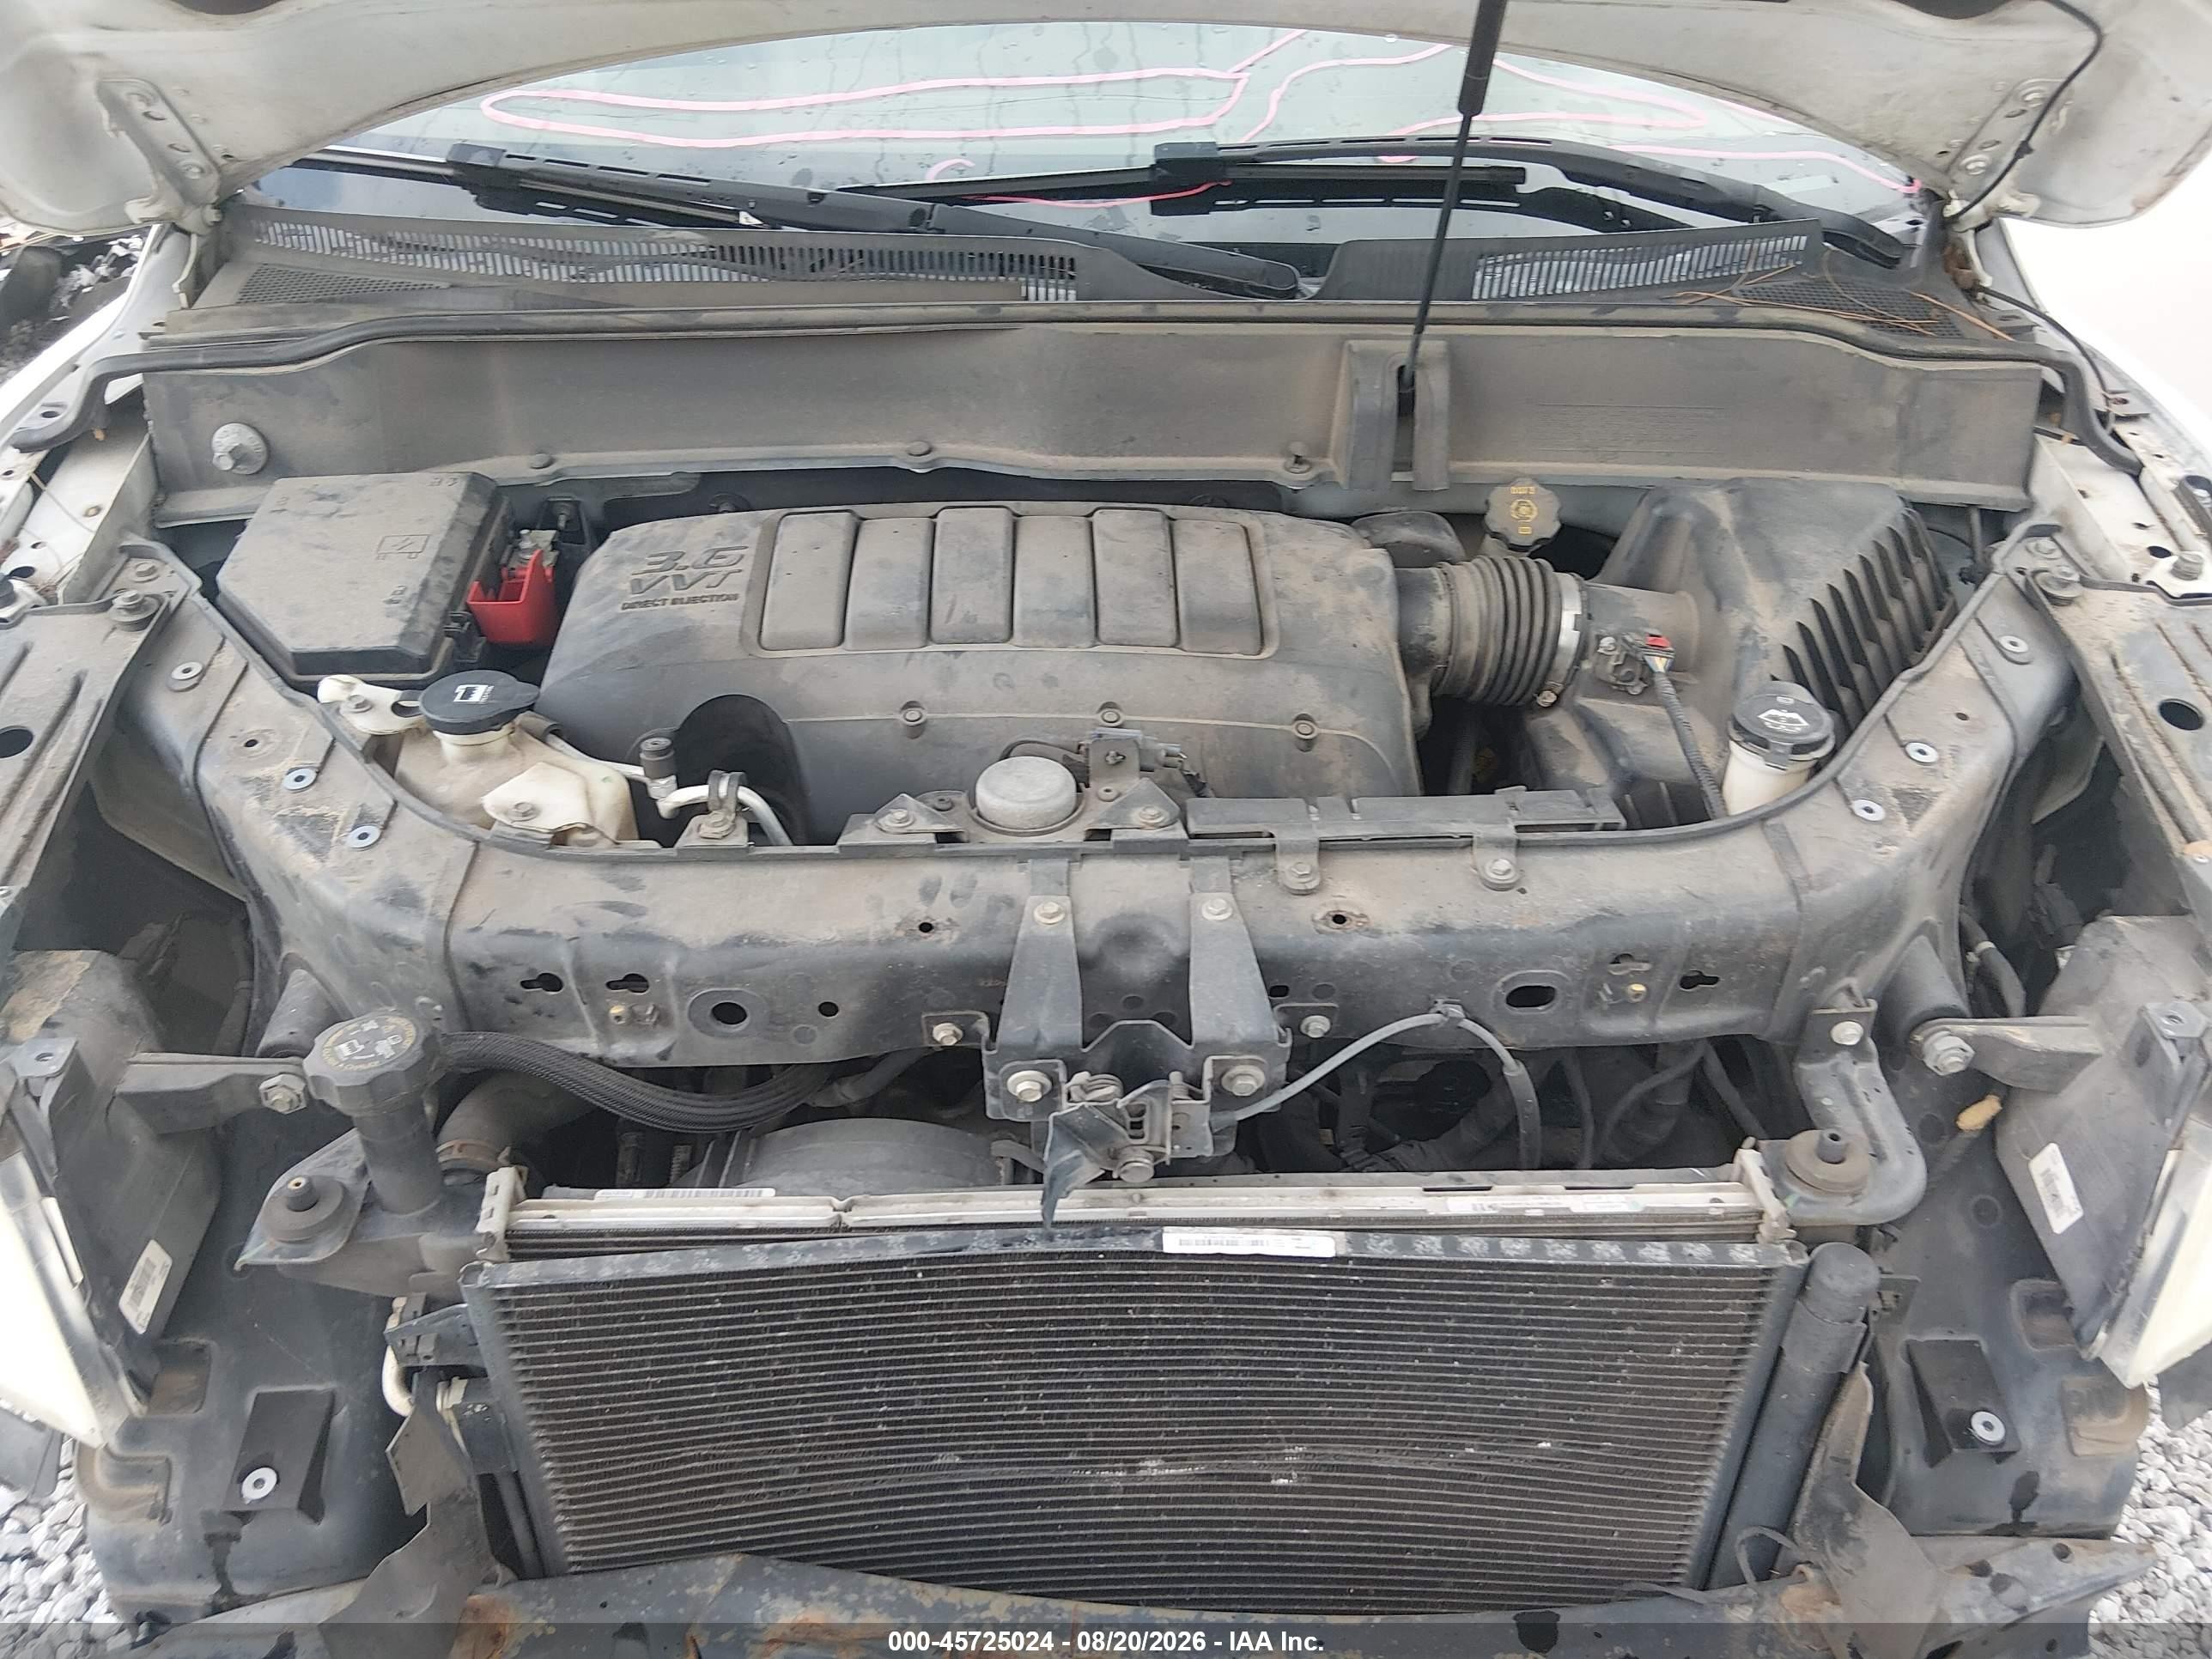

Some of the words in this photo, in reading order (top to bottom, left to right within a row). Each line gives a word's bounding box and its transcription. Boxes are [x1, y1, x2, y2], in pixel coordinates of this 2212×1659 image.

[632, 545, 749, 575] 3.6
[630, 568, 744, 596] VVT
[621, 598, 668, 611] DIRECT
[671, 593, 739, 606] INJECTION
